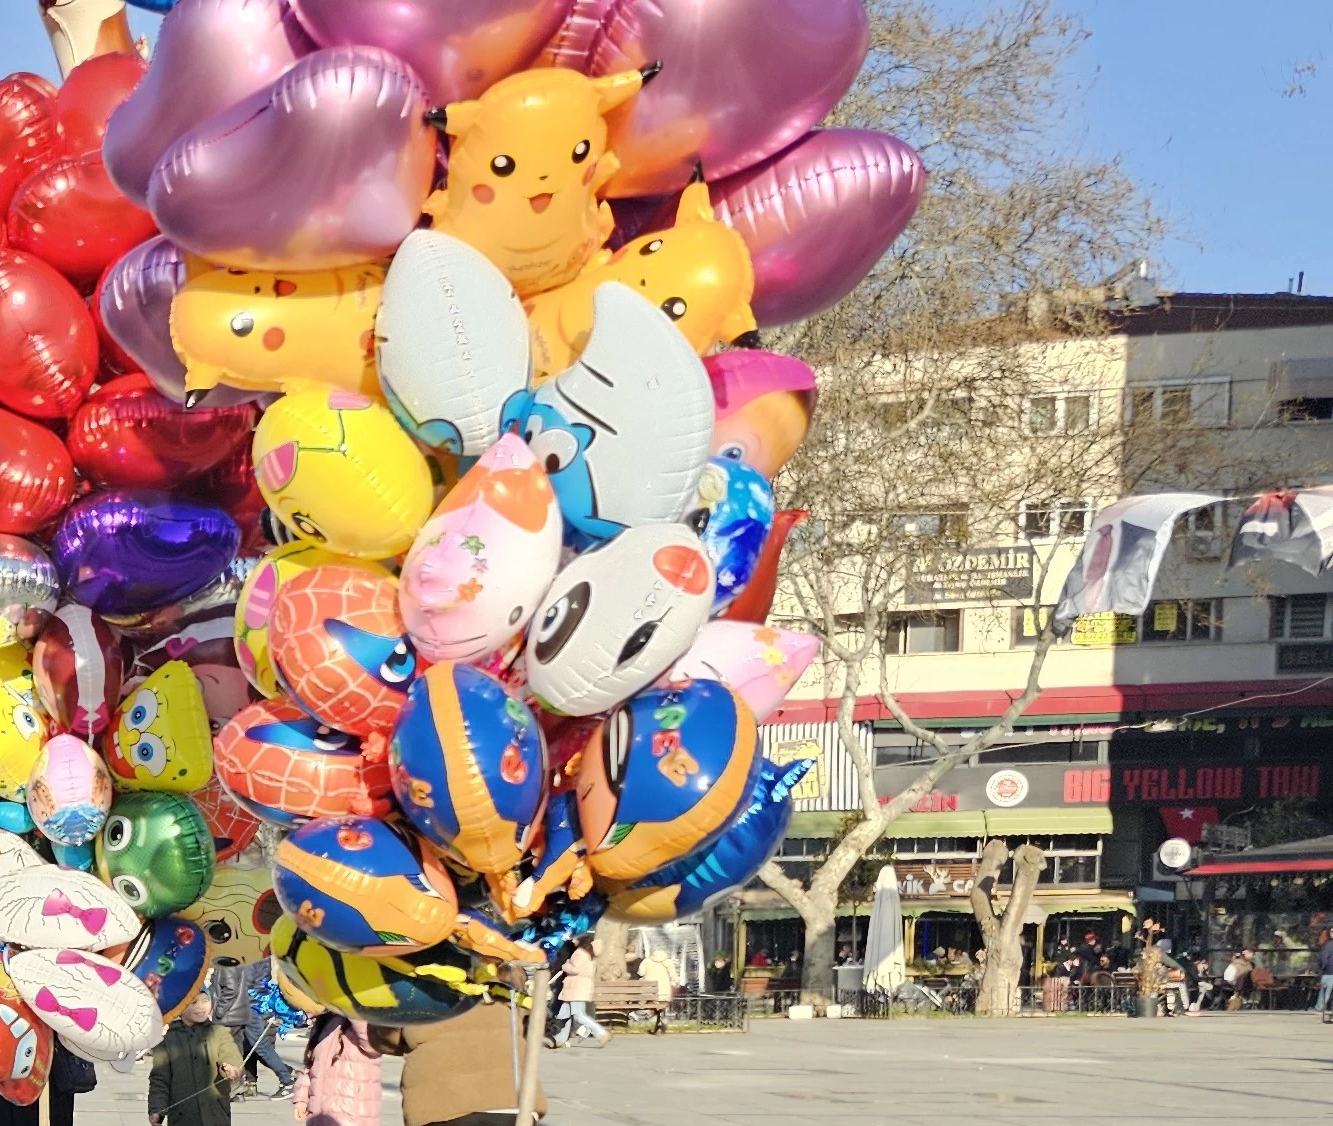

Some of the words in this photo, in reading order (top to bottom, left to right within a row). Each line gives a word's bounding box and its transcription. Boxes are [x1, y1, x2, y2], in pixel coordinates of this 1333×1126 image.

[1064, 769, 1111, 803] BIG
[1124, 768, 1243, 801] YELLOW
[1258, 765, 1321, 799] TAXI
